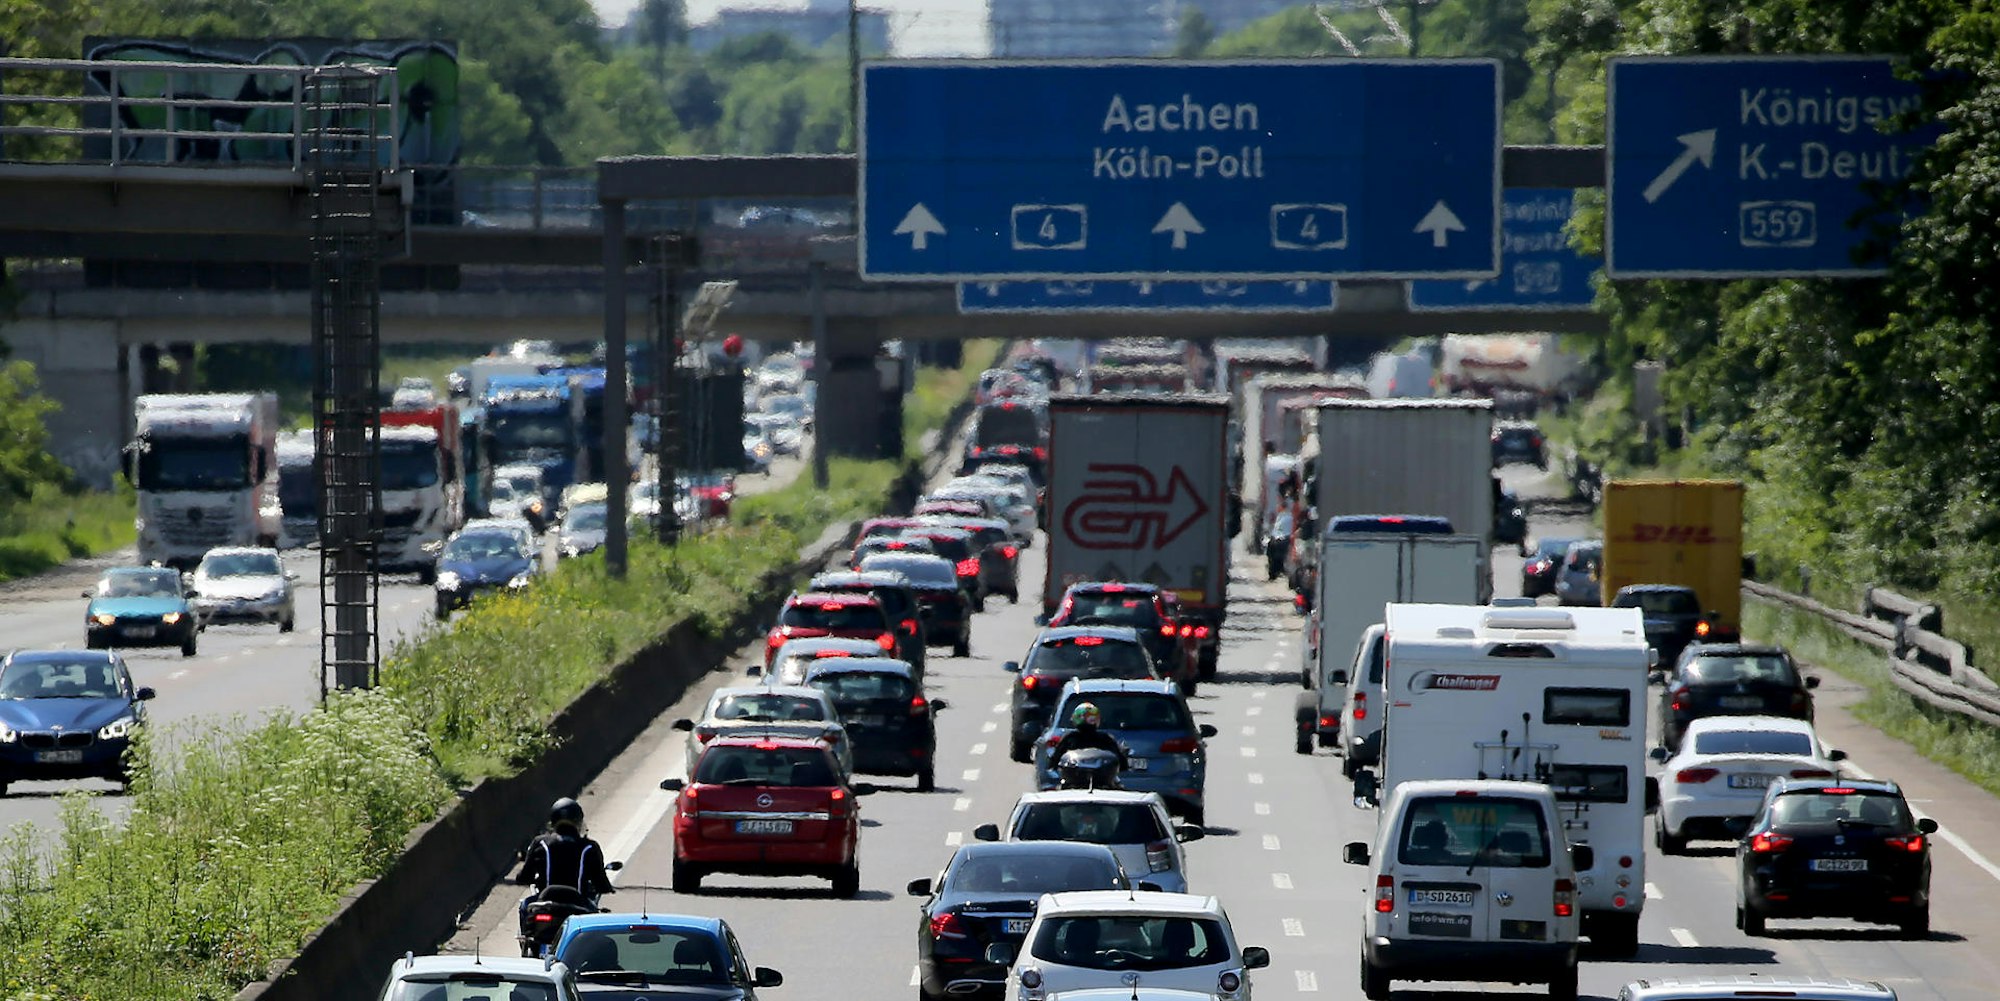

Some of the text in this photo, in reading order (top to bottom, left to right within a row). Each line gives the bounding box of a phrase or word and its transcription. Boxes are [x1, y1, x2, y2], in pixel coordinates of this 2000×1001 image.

[1103, 93, 1259, 133] Aachen
[1093, 144, 1265, 179] Köln-Poll
[1038, 212, 1057, 242] 4
[1300, 212, 1319, 242] 4
[1751, 208, 1804, 239] 559
[1632, 523, 1717, 545] DHL
[1435, 675, 1496, 691] Challenger
[1453, 807, 1497, 825] WM
[1410, 915, 1470, 926] info@wm.de
